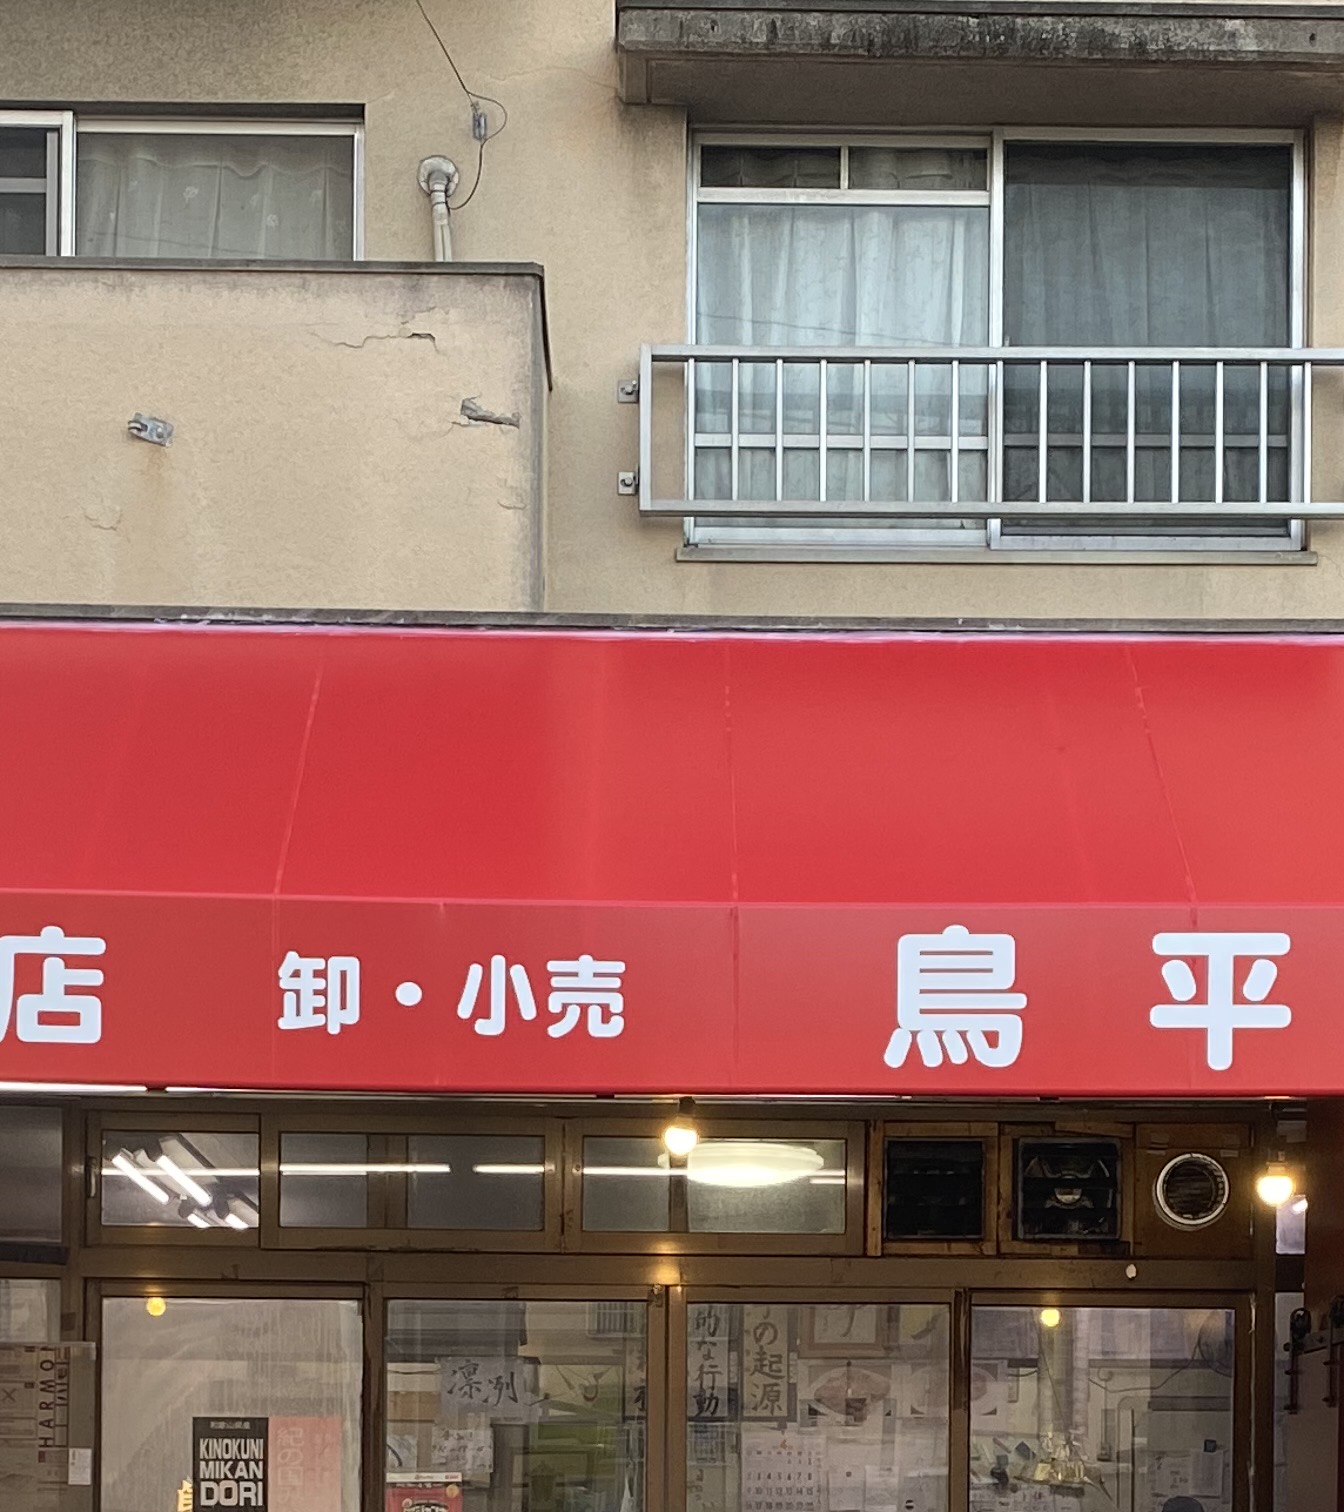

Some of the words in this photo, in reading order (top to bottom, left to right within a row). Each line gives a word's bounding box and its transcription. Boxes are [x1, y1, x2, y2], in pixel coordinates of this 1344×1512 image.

[277, 951, 626, 1038] 卸・小売
[883, 924, 1292, 1071] 鳥平
[749, 1304, 785, 1417] の起源
[199, 1438, 264, 1460] KINOKUNI
[199, 1461, 264, 1479] MIKAN
[200, 1480, 264, 1507] DORI
